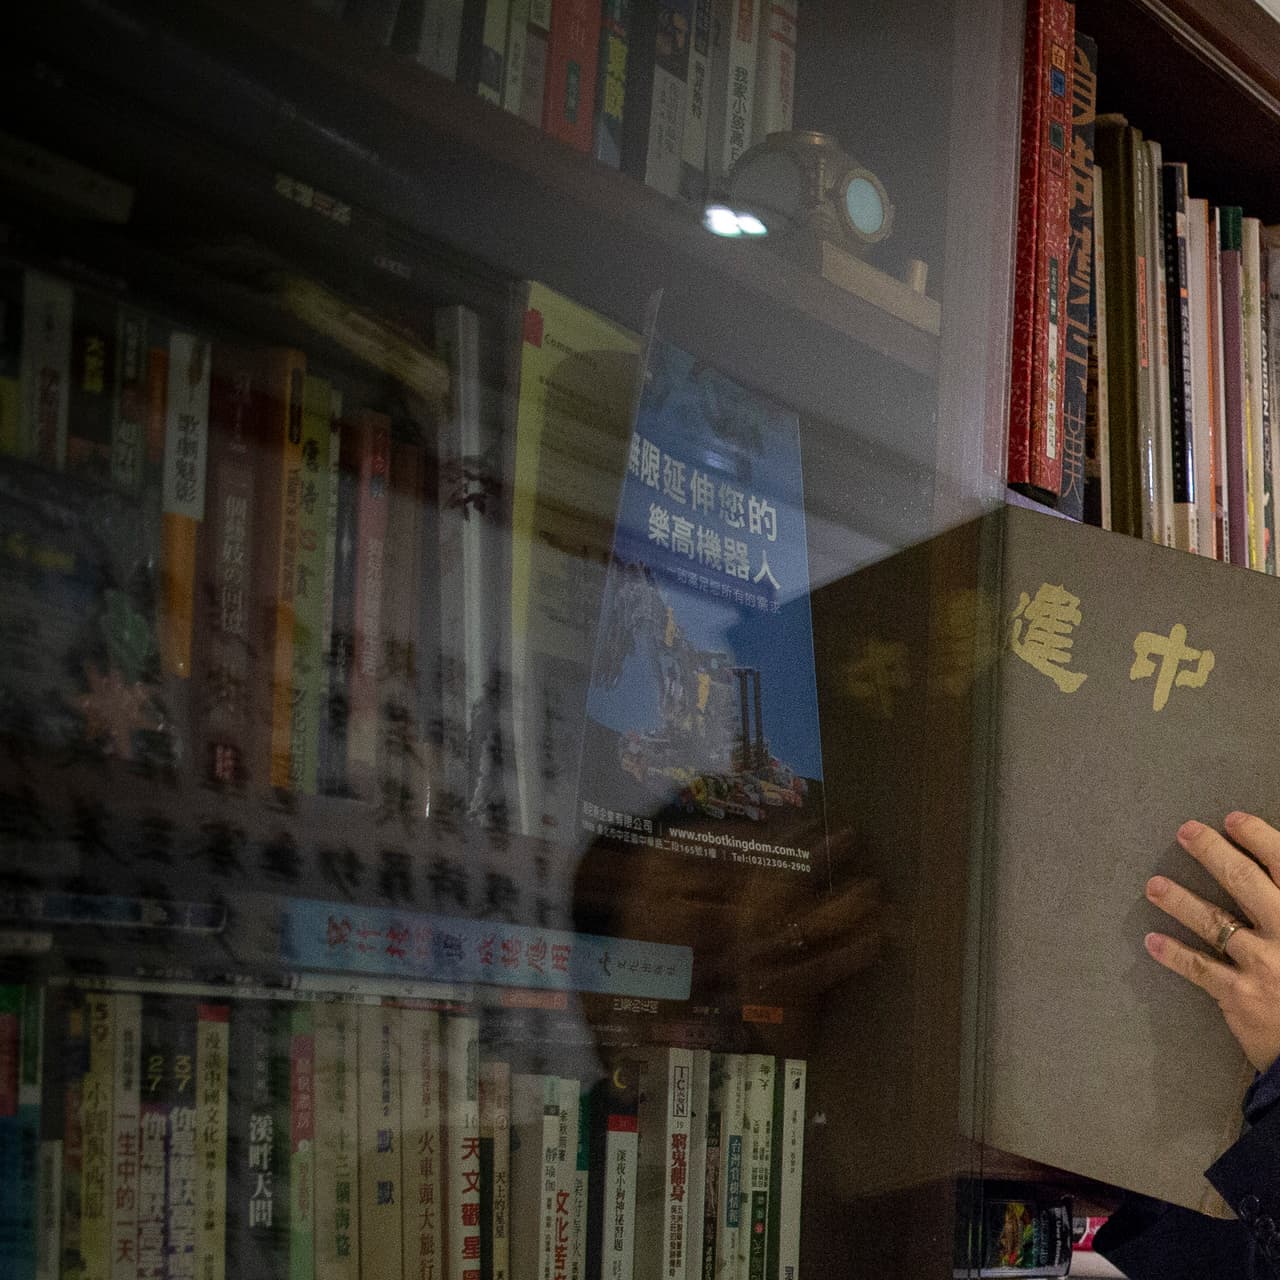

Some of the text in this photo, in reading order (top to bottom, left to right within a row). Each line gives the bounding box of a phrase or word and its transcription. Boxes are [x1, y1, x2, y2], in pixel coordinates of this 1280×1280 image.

[648, 502, 782, 590] 樂高機器人
[668, 826, 810, 860] www.robotkingdom.com.tw
[670, 1133, 688, 1203] 窮鬼翻身
